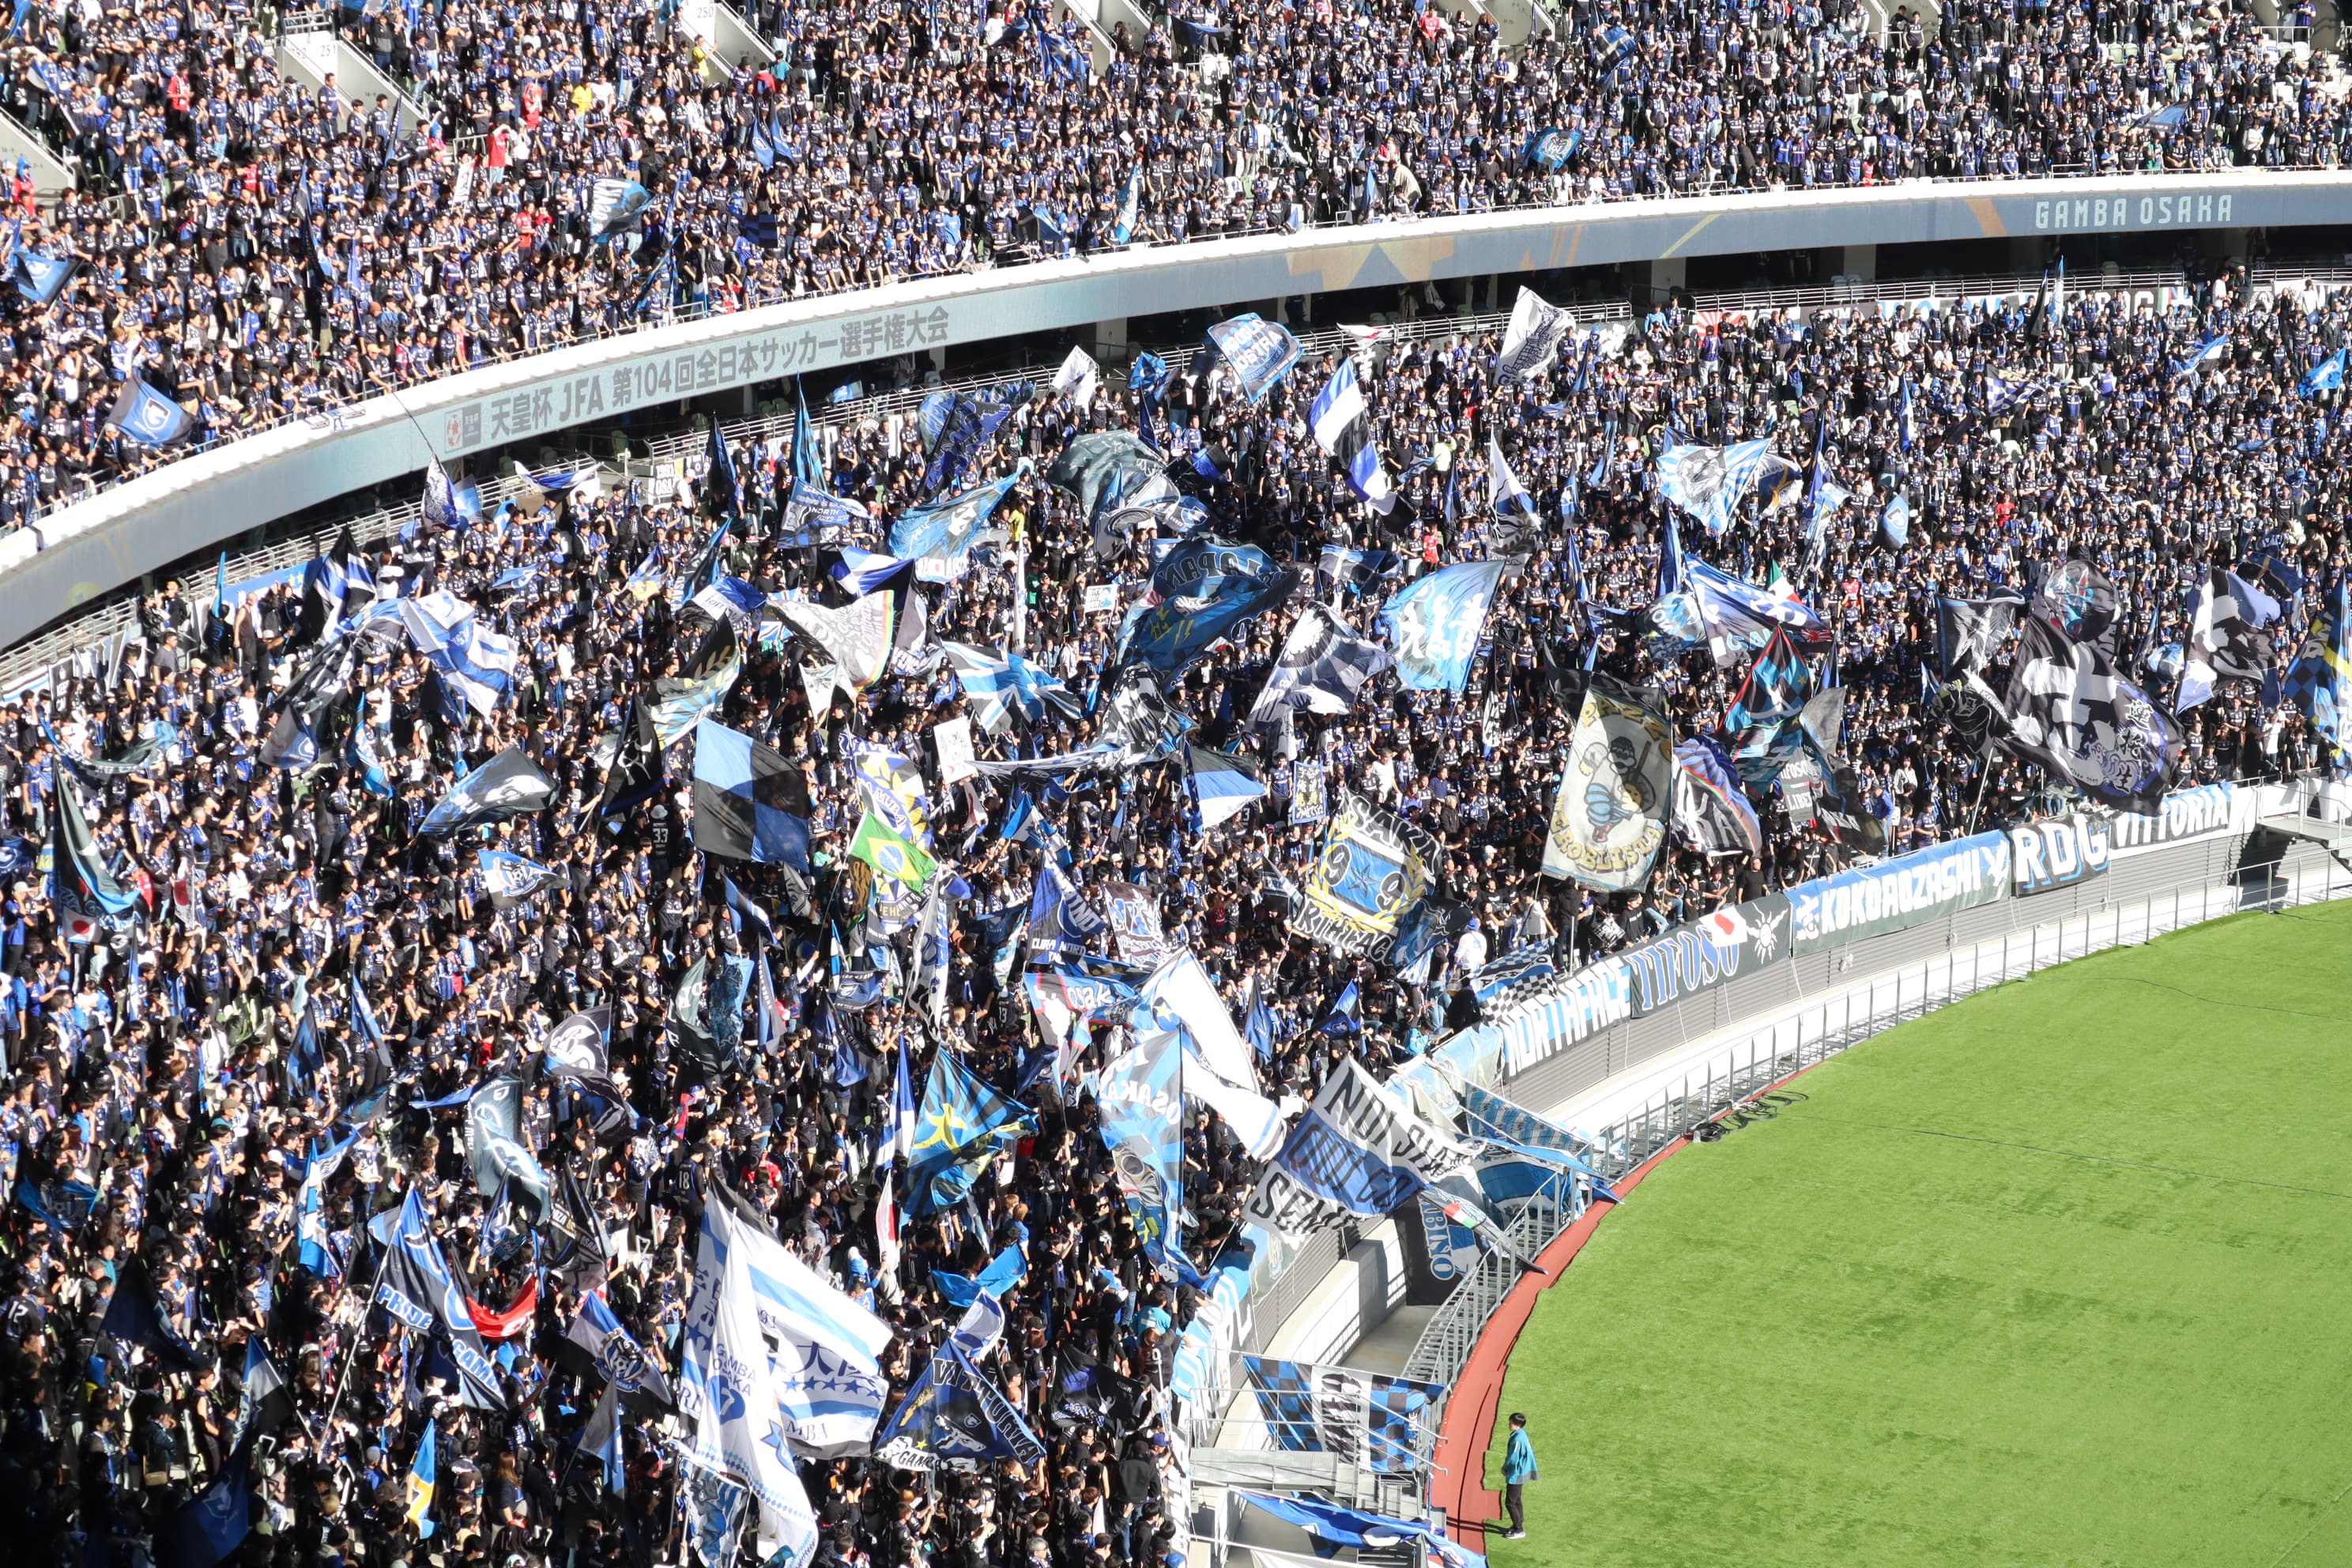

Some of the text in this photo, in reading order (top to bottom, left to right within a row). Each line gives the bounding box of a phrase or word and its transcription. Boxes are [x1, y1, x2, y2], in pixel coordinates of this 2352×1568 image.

[697, 6, 714, 17] 250
[2036, 195, 2233, 229] GAMBA OSAKA
[491, 306, 948, 439] 天皇杯 JFA 第104回全日本サッカー選手権大会
[653, 828, 669, 843] 33
[2116, 790, 2228, 847] VITTORIA
[1325, 842, 1352, 887] 9
[2014, 813, 2108, 883] RDG
[1821, 850, 1981, 934] KOKOROZASHI
[998, 1007, 1008, 1023] 13
[1325, 1068, 1396, 1147] NOI
[679, 1170, 691, 1189] 18
[8, 1300, 28, 1324] 12
[375, 1282, 434, 1329] PRIDE
